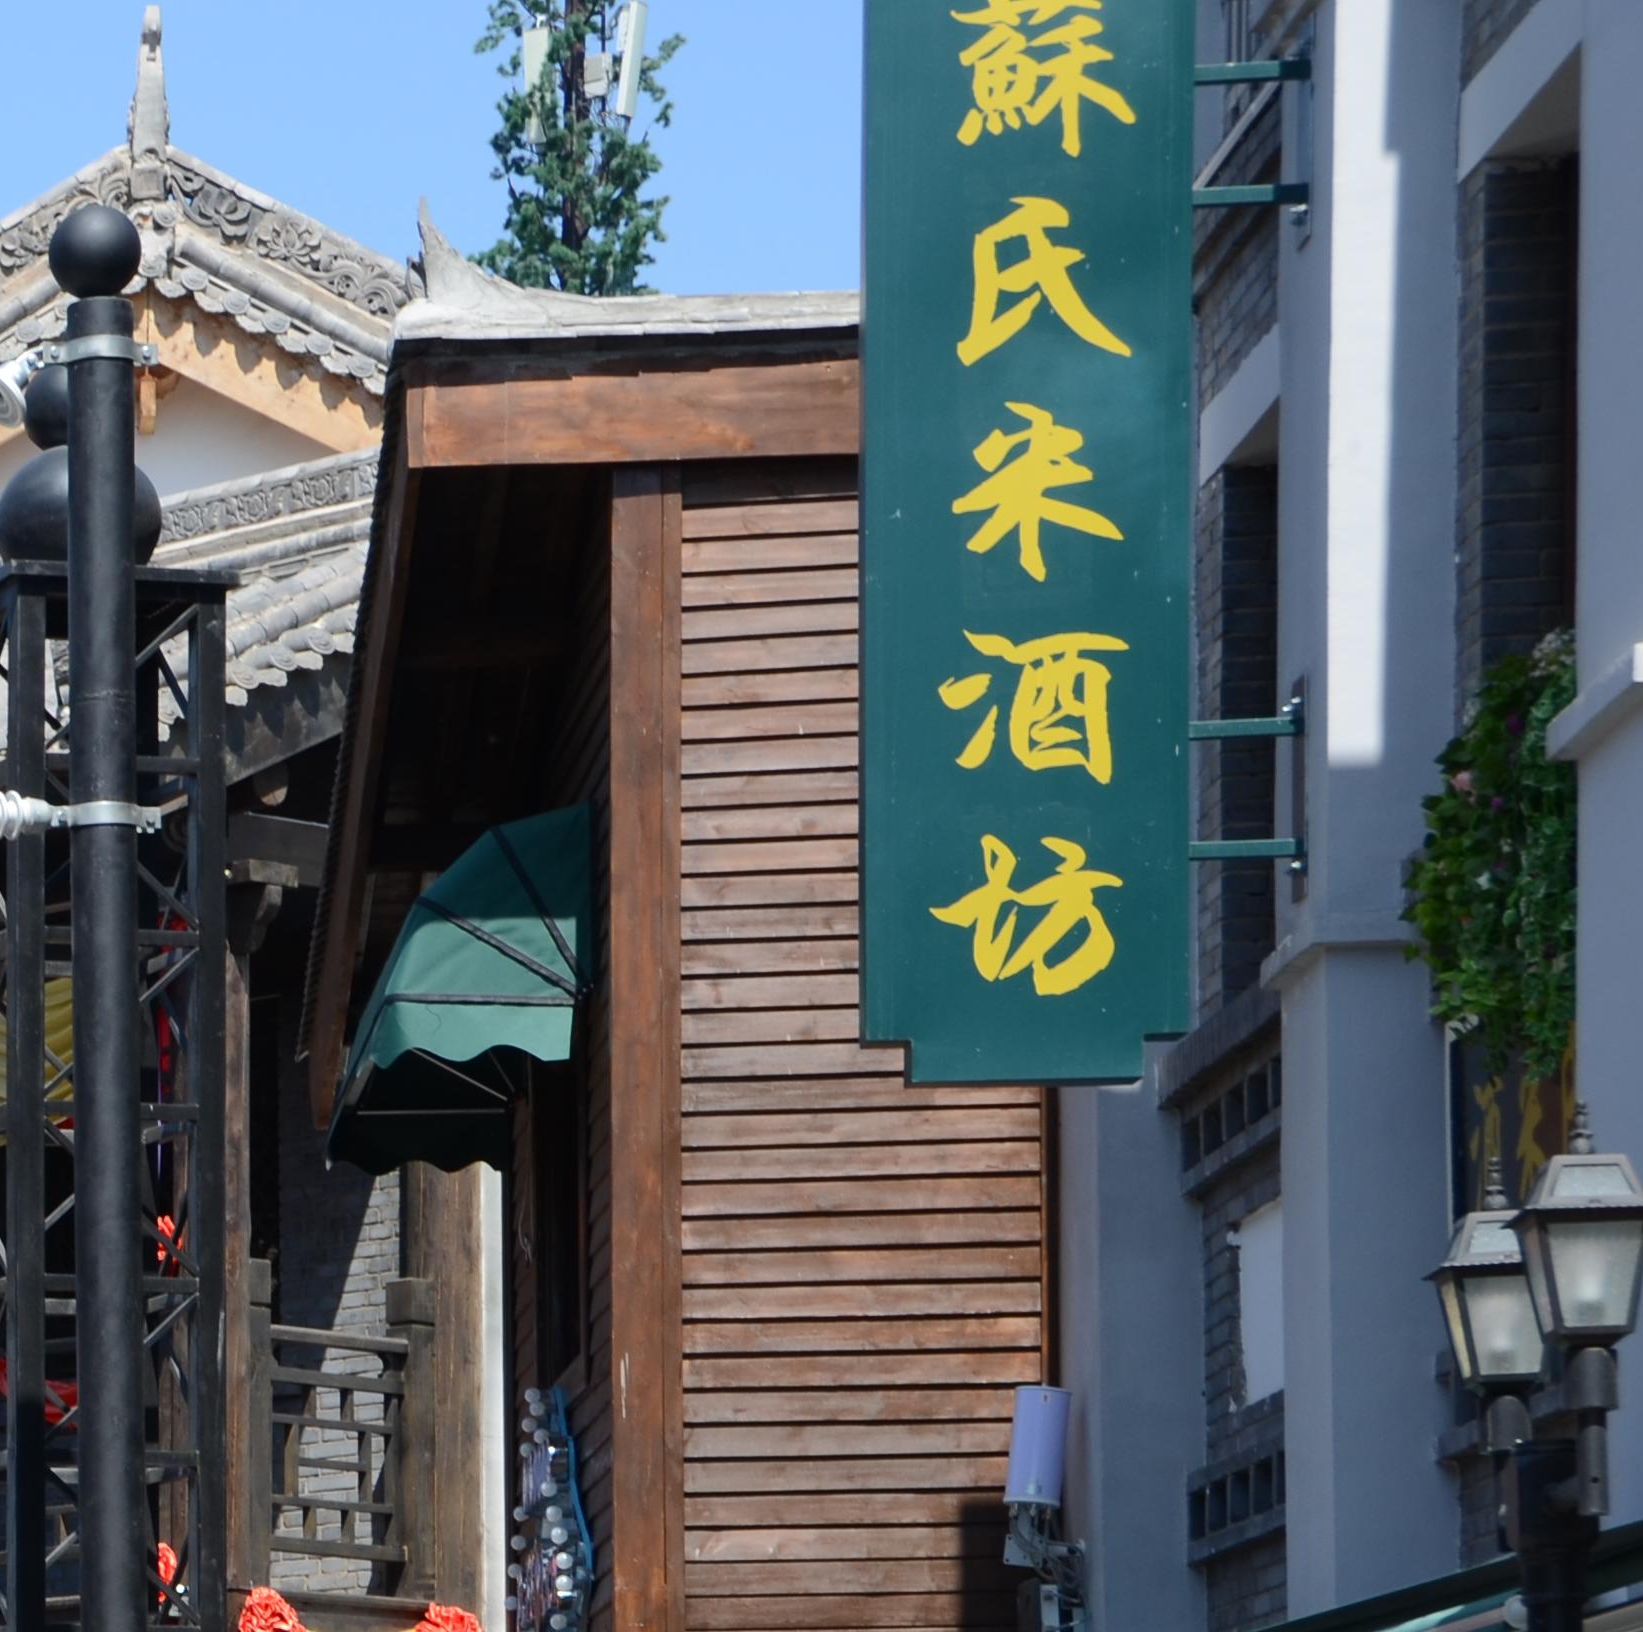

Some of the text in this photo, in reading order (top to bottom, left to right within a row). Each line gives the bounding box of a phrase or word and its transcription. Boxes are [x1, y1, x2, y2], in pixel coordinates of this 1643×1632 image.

[928, 0, 1136, 997] 蘇氏米酒坊
